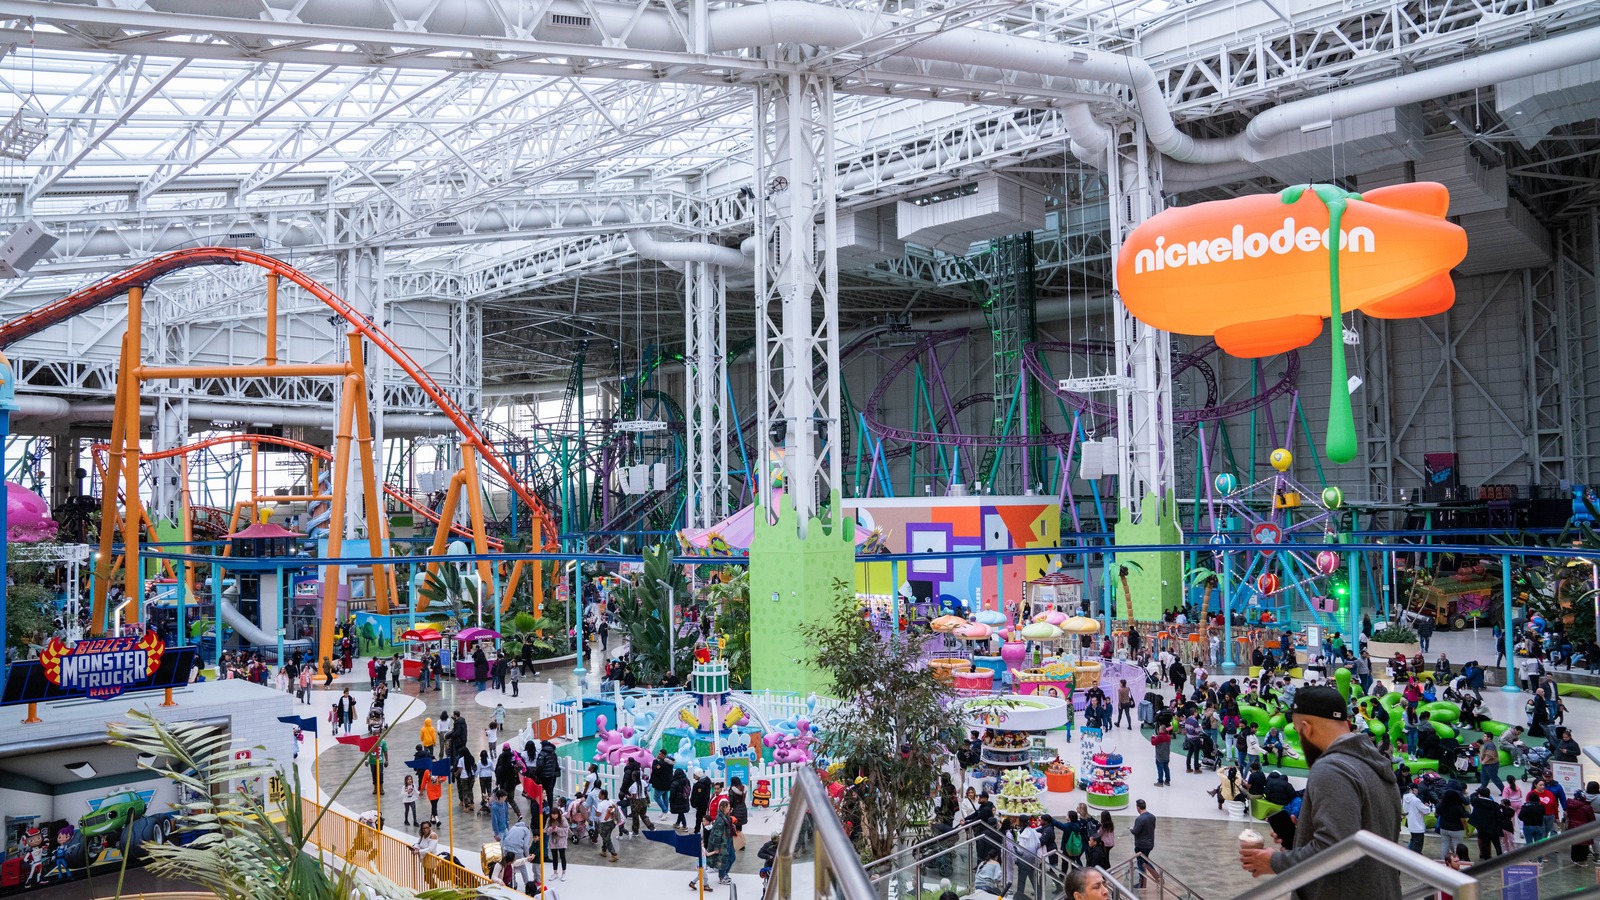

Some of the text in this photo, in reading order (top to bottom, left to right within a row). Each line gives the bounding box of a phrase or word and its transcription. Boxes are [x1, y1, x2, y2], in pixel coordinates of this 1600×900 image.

[1134, 216, 1376, 275] nickelodeon
[74, 637, 136, 655] BLAZE'S
[62, 650, 146, 687] MONSTER
[78, 669, 134, 688] TRUCK
[89, 686, 122, 697] RALLY
[721, 743, 748, 757] Blue's
